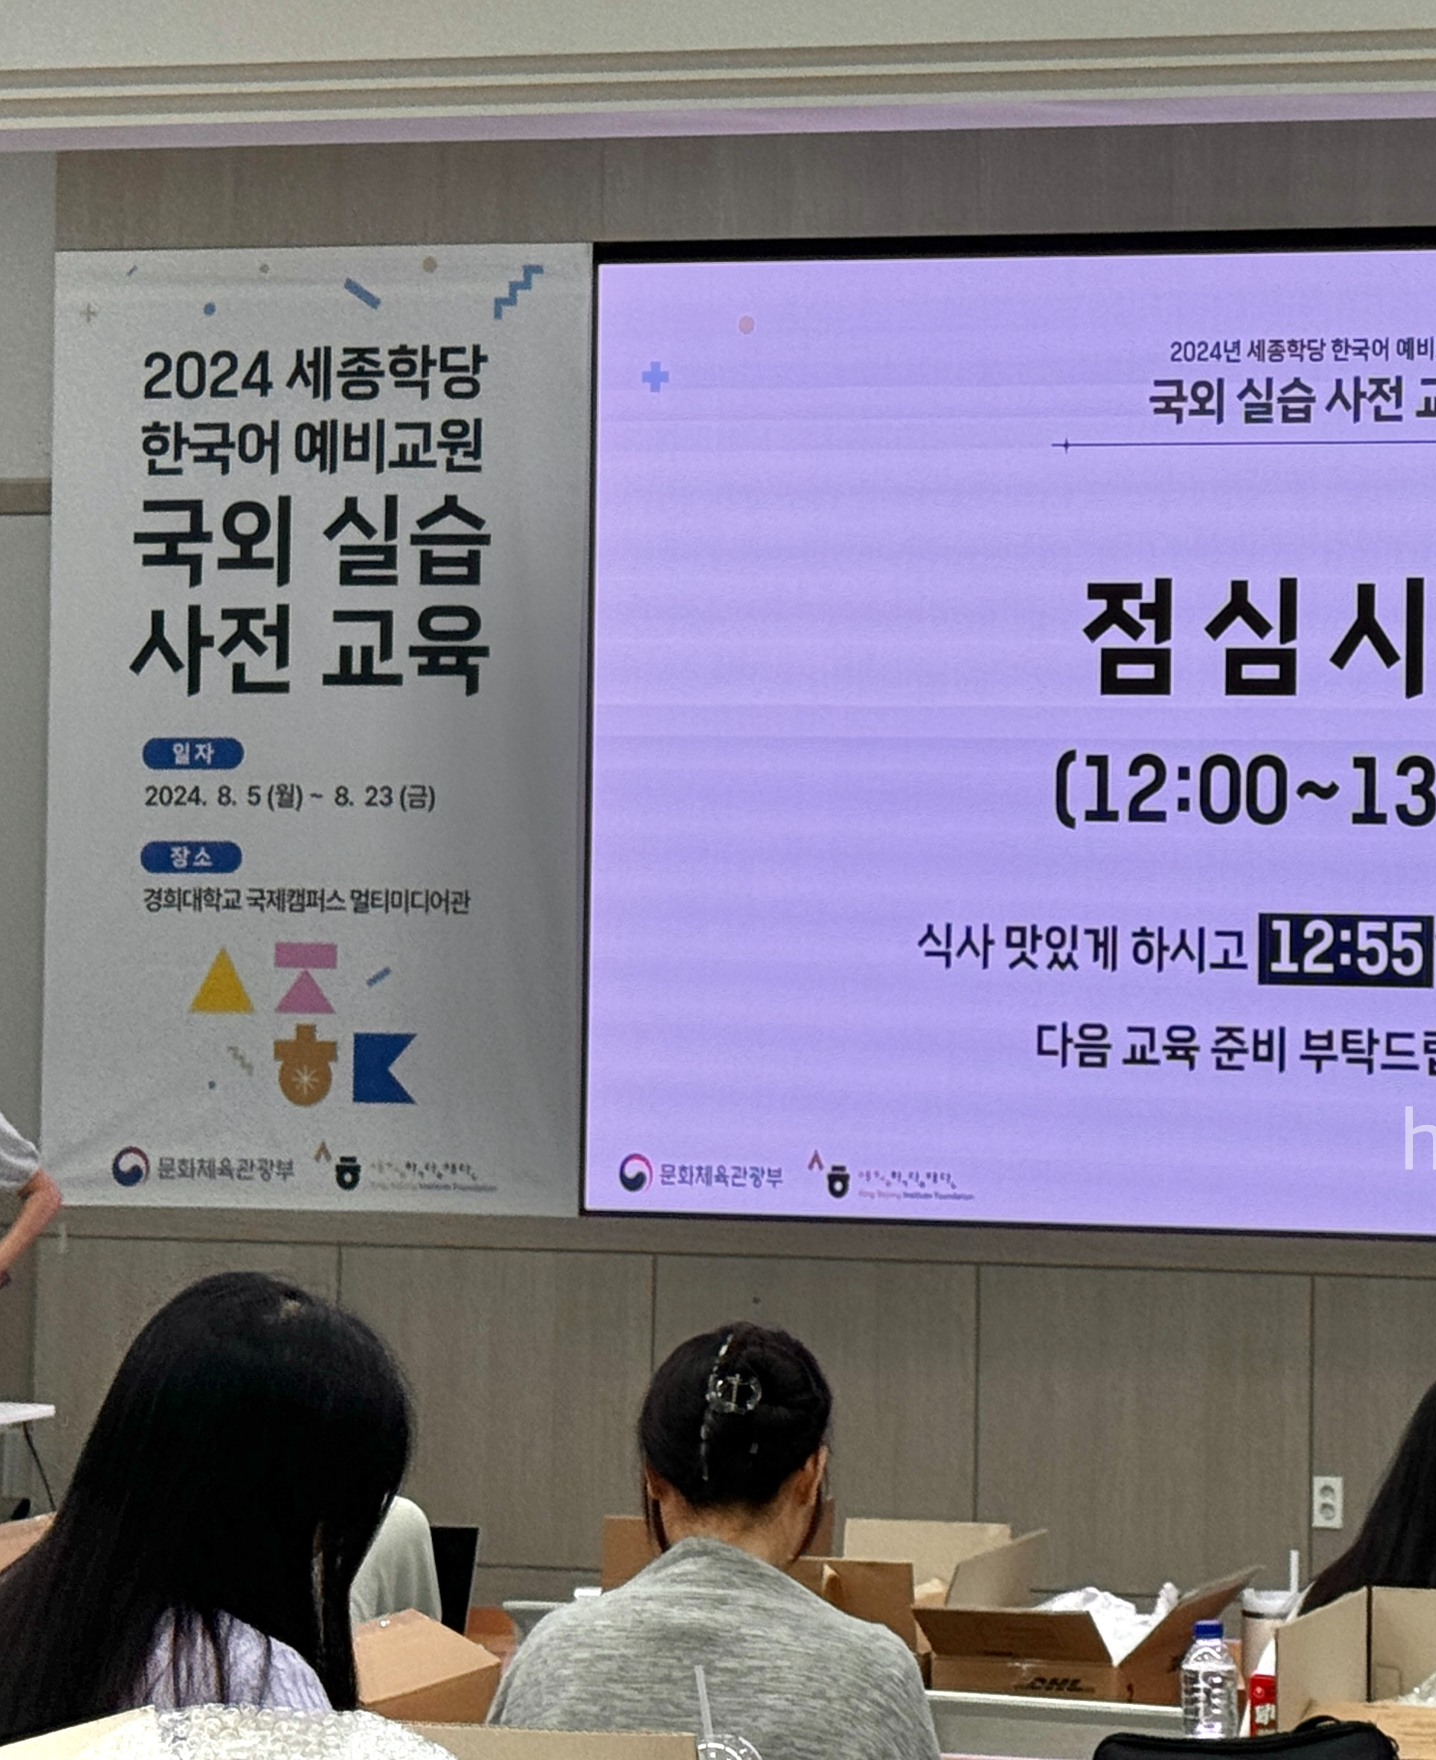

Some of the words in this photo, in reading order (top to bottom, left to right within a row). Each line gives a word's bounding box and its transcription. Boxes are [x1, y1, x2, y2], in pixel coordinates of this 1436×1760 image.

[143, 350, 274, 400] 2024
[285, 344, 489, 402] 세종학당
[1170, 339, 1241, 364] 2024년
[1246, 338, 1327, 363] 세종학당
[1331, 337, 1390, 362] 한국어
[1148, 377, 1225, 425] 국외
[1236, 376, 1317, 425] 실습
[1324, 375, 1403, 424] 사전
[141, 419, 280, 476] 한국어
[294, 417, 483, 475] 예비교원
[133, 495, 292, 589] 국외
[322, 494, 492, 587] 실습
[129, 603, 290, 697] 사전
[322, 604, 490, 698] 교육
[143, 886, 242, 913] 경희대학교
[246, 888, 347, 914] 국제캠퍼스
[350, 888, 472, 916] 멀티미디어관
[917, 922, 995, 970] 식사
[1005, 923, 1118, 972] 맛있게
[1131, 925, 1248, 974] 하시고
[1037, 1021, 1112, 1069] 다음
[1122, 1025, 1200, 1071] 교육
[1210, 1026, 1286, 1073] 준비
[157, 1157, 295, 1183] 문화체육관광부
[659, 1163, 783, 1189] 문화체육관광부
